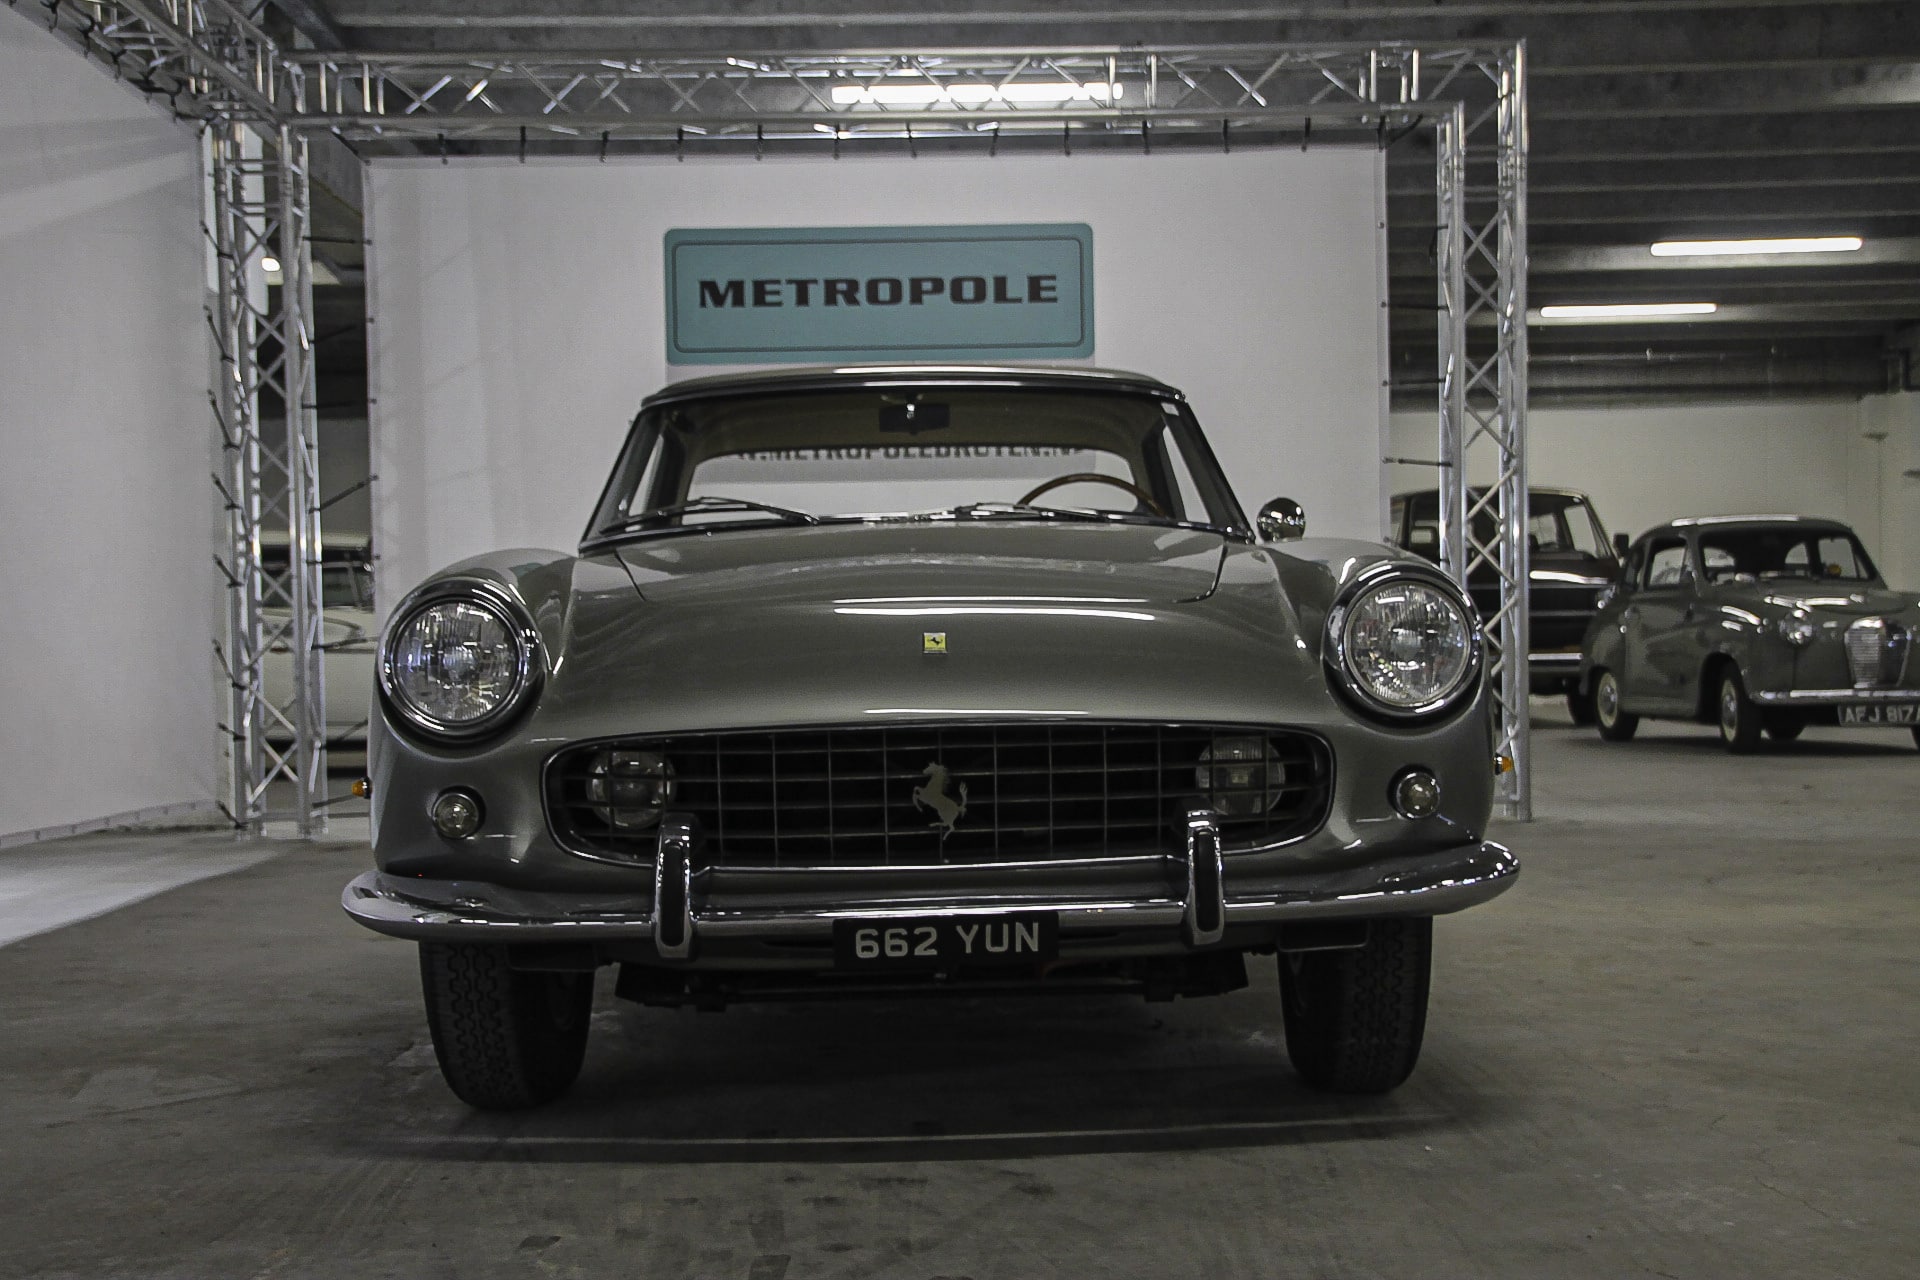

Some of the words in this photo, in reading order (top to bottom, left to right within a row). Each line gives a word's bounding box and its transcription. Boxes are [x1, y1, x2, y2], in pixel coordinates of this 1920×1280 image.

[698, 275, 1058, 309] METROPOLE
[1845, 705, 1880, 723] AFJ
[855, 926, 938, 959] 662
[956, 922, 1039, 954] YUN
